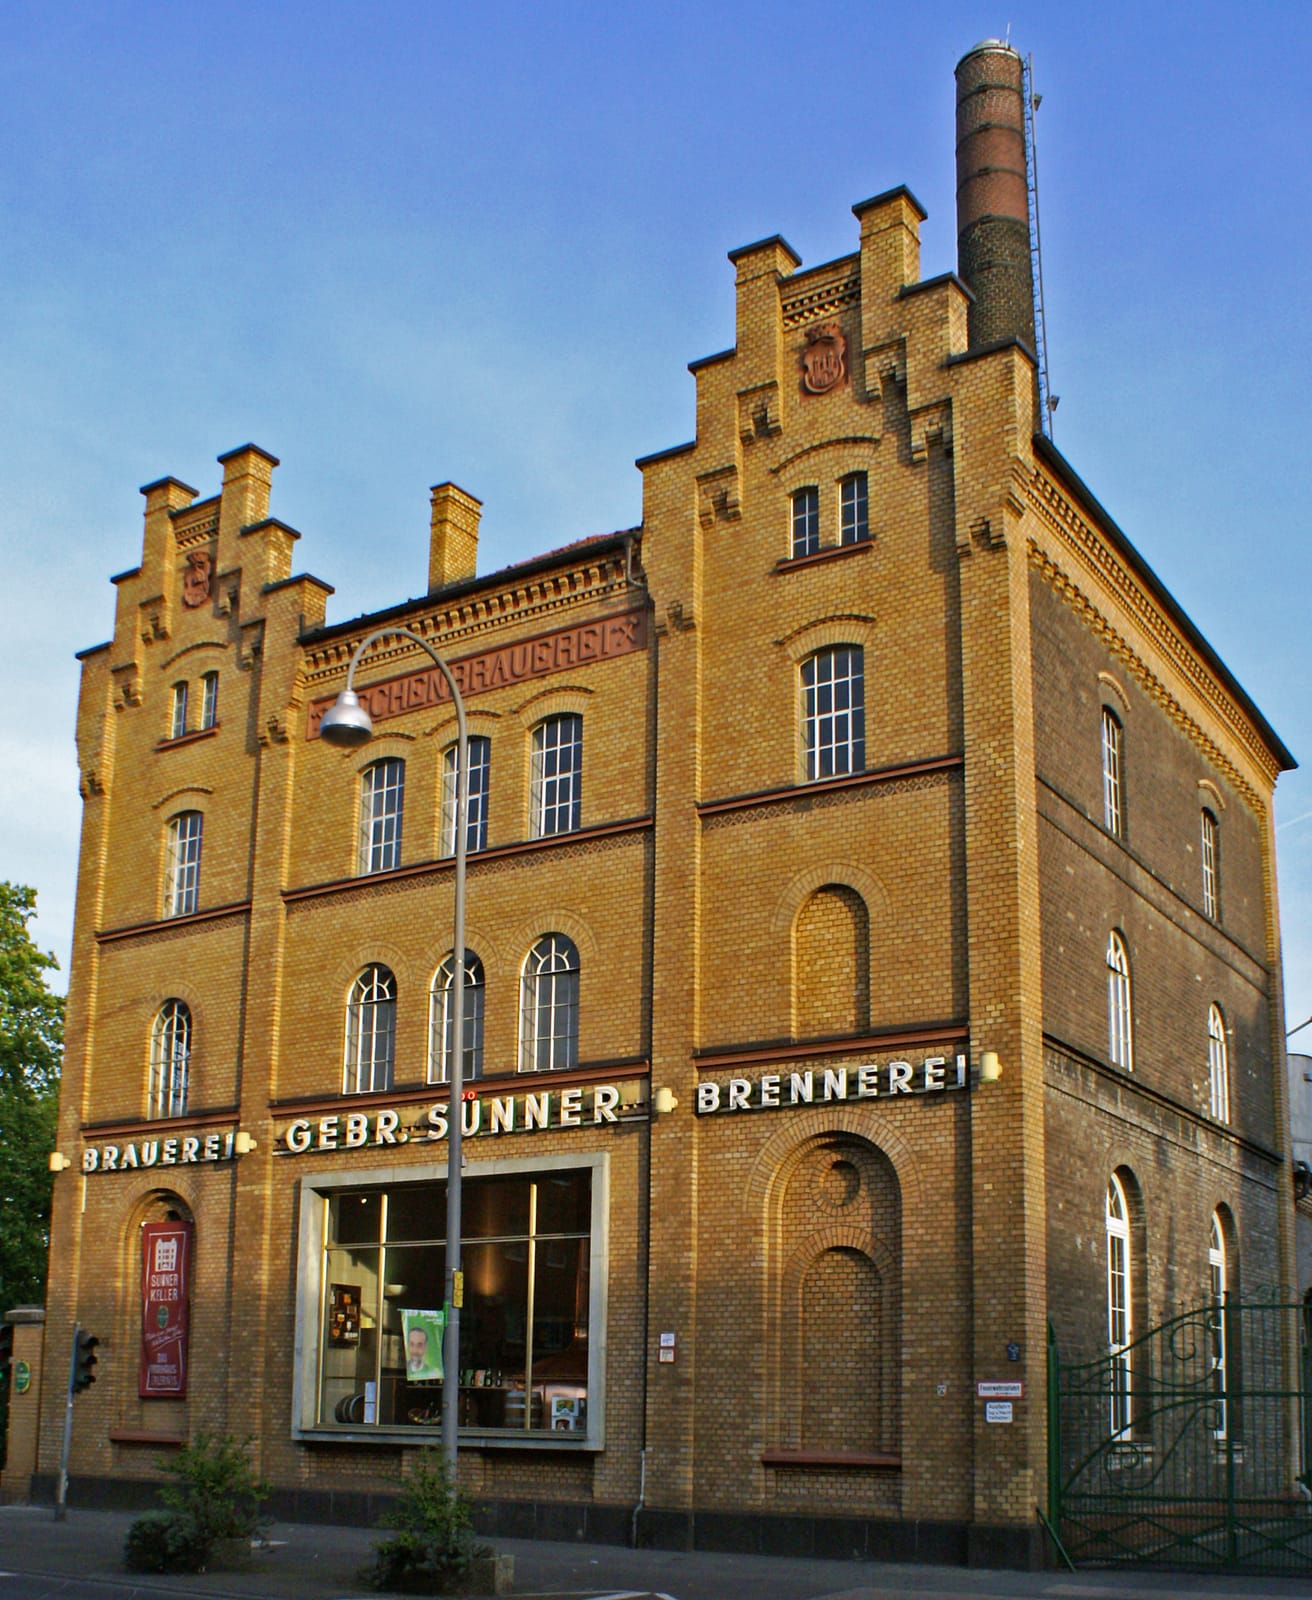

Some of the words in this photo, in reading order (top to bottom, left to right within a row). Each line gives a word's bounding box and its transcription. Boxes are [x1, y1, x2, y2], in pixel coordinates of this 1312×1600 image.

[338, 621, 609, 722] CHENBRAUEREI
[696, 1053, 968, 1114] BRENNEREI
[285, 1109, 410, 1153] GEBR.
[427, 1084, 621, 1141] SÜNNER
[82, 1131, 235, 1173] BRAUEREI
